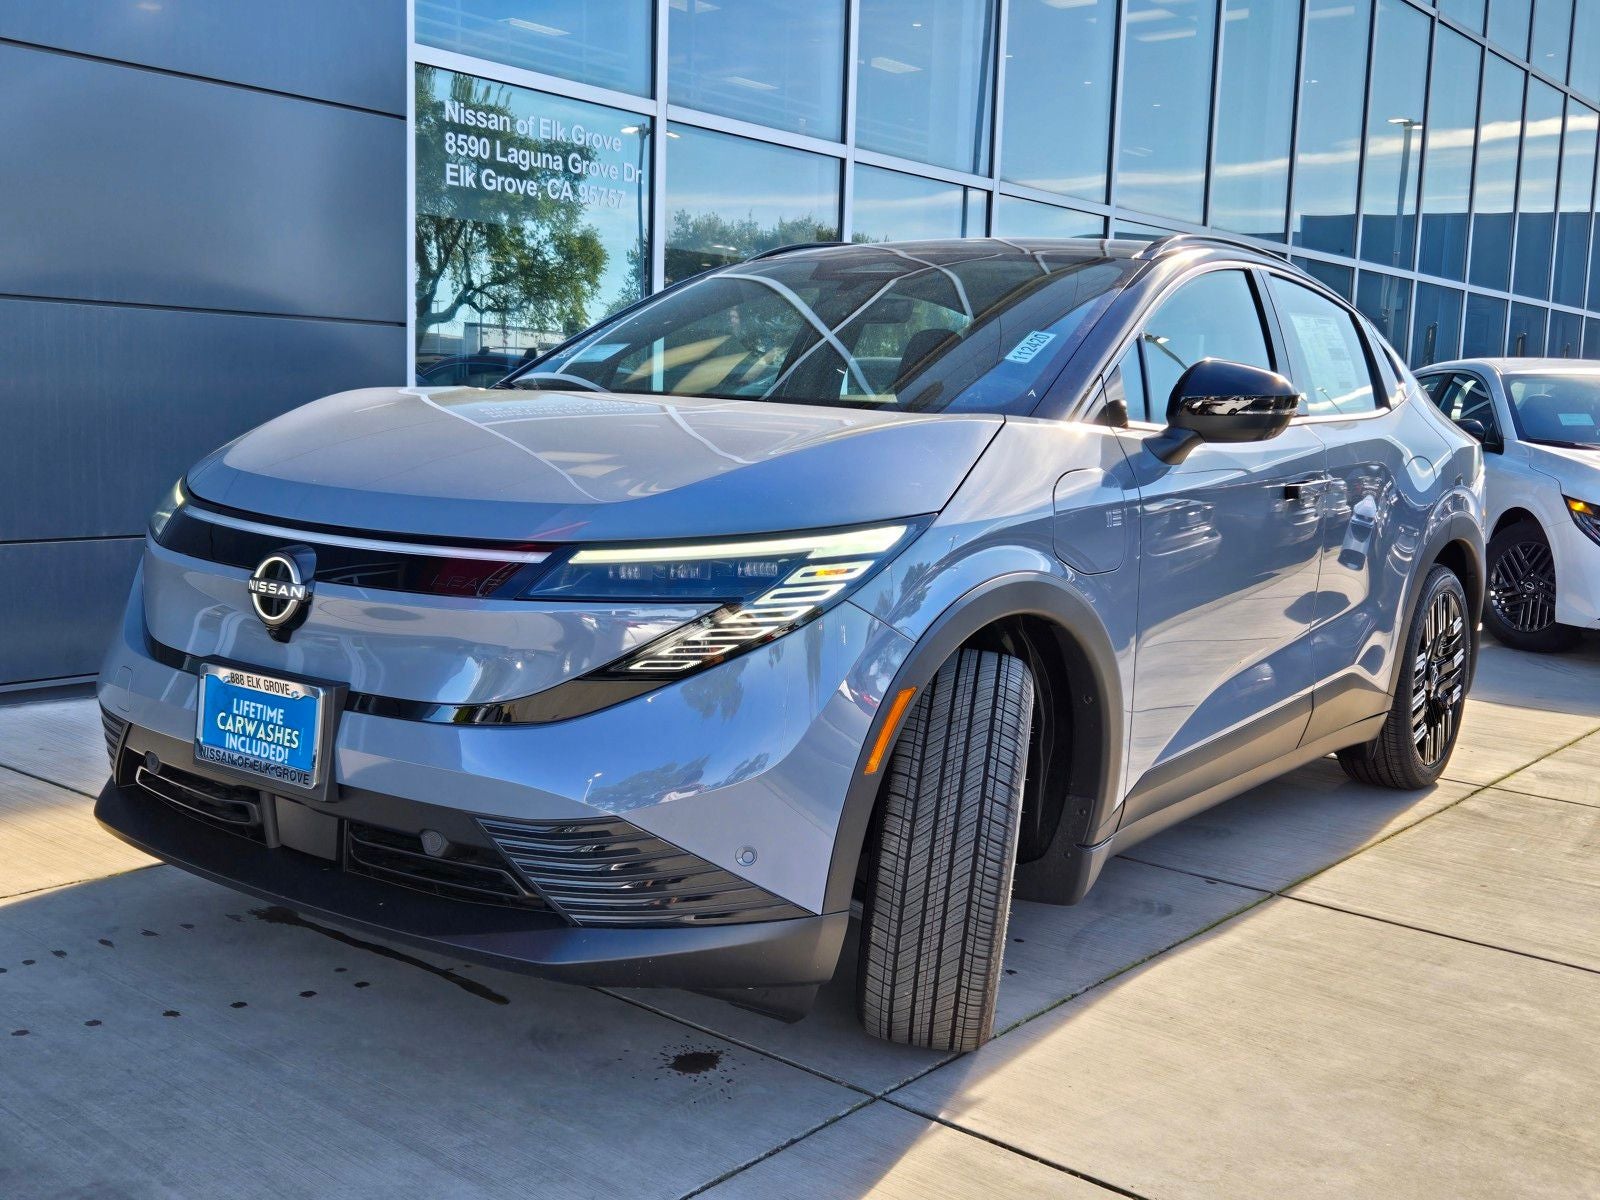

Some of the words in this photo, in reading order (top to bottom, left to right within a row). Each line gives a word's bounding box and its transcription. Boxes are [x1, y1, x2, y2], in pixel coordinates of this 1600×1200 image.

[445, 101, 511, 132] Nissan
[516, 116, 534, 136] of
[539, 118, 566, 142] Elk
[571, 125, 622, 151] Grove
[445, 132, 490, 159] 8590
[496, 140, 563, 171] Laguna
[568, 153, 618, 179] Grove
[623, 162, 644, 184] Dr.
[445, 163, 477, 189] Elk
[481, 169, 542, 200] Grove,
[547, 178, 573, 201] CA
[578, 184, 625, 209] 95757
[1012, 333, 1050, 360] 112420
[248, 579, 303, 599] NISSAN
[247, 675, 262, 691] ELK
[264, 679, 290, 695] GROVE
[233, 698, 284, 725] LIFETIME
[217, 712, 299, 748] CARWASHES
[225, 733, 289, 764] INCLUDED!
[200, 746, 236, 766] NISSAN
[237, 755, 251, 768] OF
[252, 760, 272, 775] ELK
[275, 765, 310, 785] GROVE
